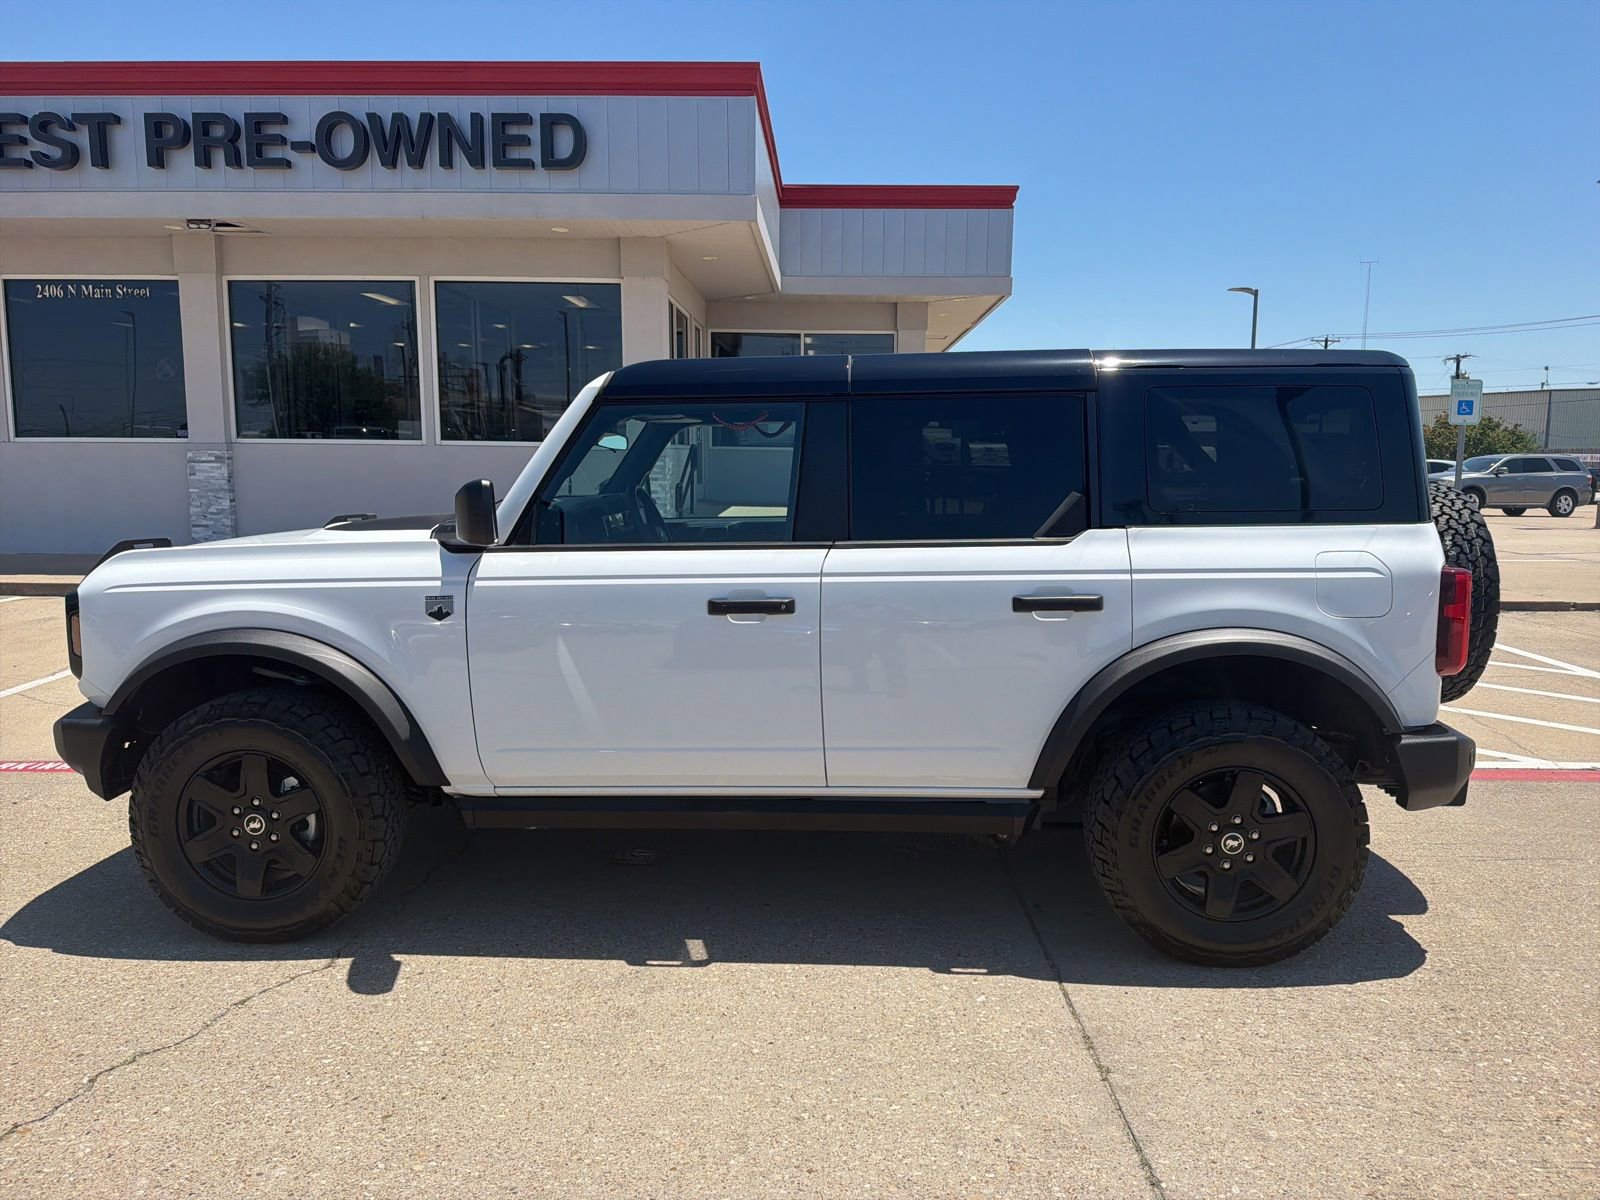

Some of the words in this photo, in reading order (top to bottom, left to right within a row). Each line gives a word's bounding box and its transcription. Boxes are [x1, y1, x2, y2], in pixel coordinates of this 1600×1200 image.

[143, 110, 588, 171] PRE-OWNED
[35, 284, 64, 298] 2406
[67, 284, 77, 298] N
[81, 284, 112, 299] Main
[115, 284, 151, 299] Street
